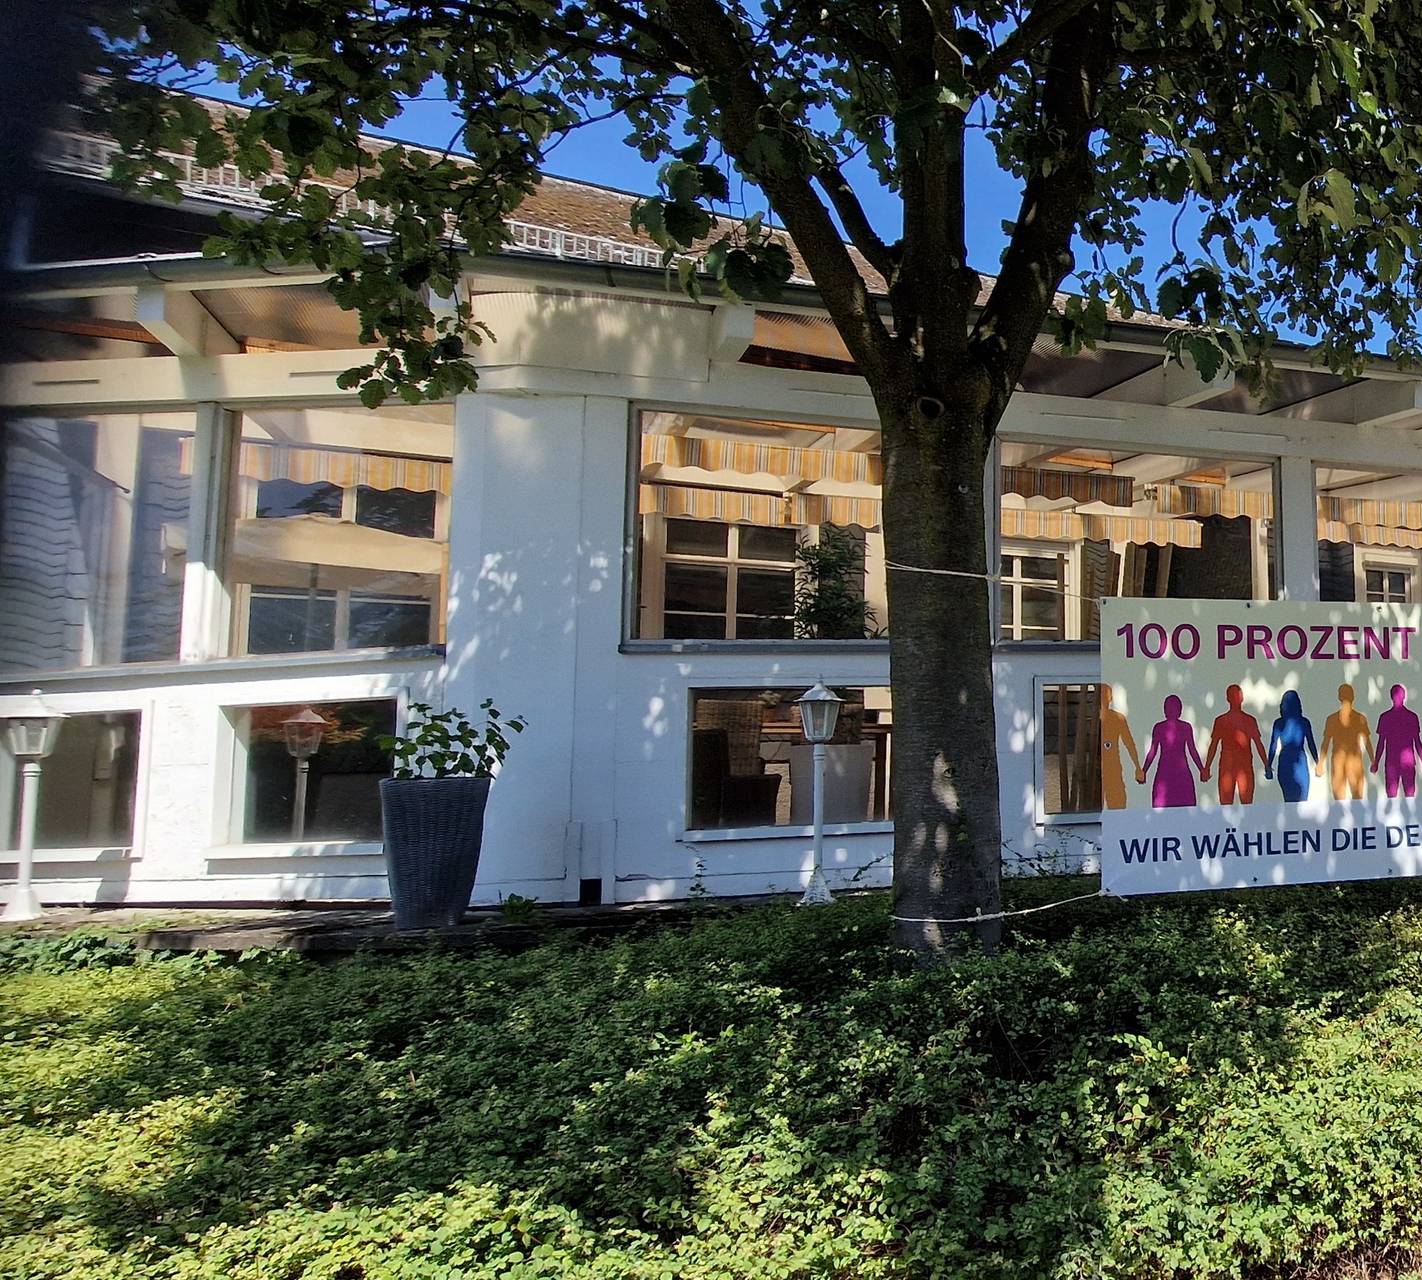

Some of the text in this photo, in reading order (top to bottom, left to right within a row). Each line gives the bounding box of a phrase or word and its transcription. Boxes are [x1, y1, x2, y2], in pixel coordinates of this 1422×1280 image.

[1116, 623, 1201, 660] 100
[1216, 624, 1416, 660] PROZENT
[1119, 836, 1182, 864] WIR
[1191, 828, 1322, 860] WÄHLEN
[1331, 826, 1377, 852] DIE
